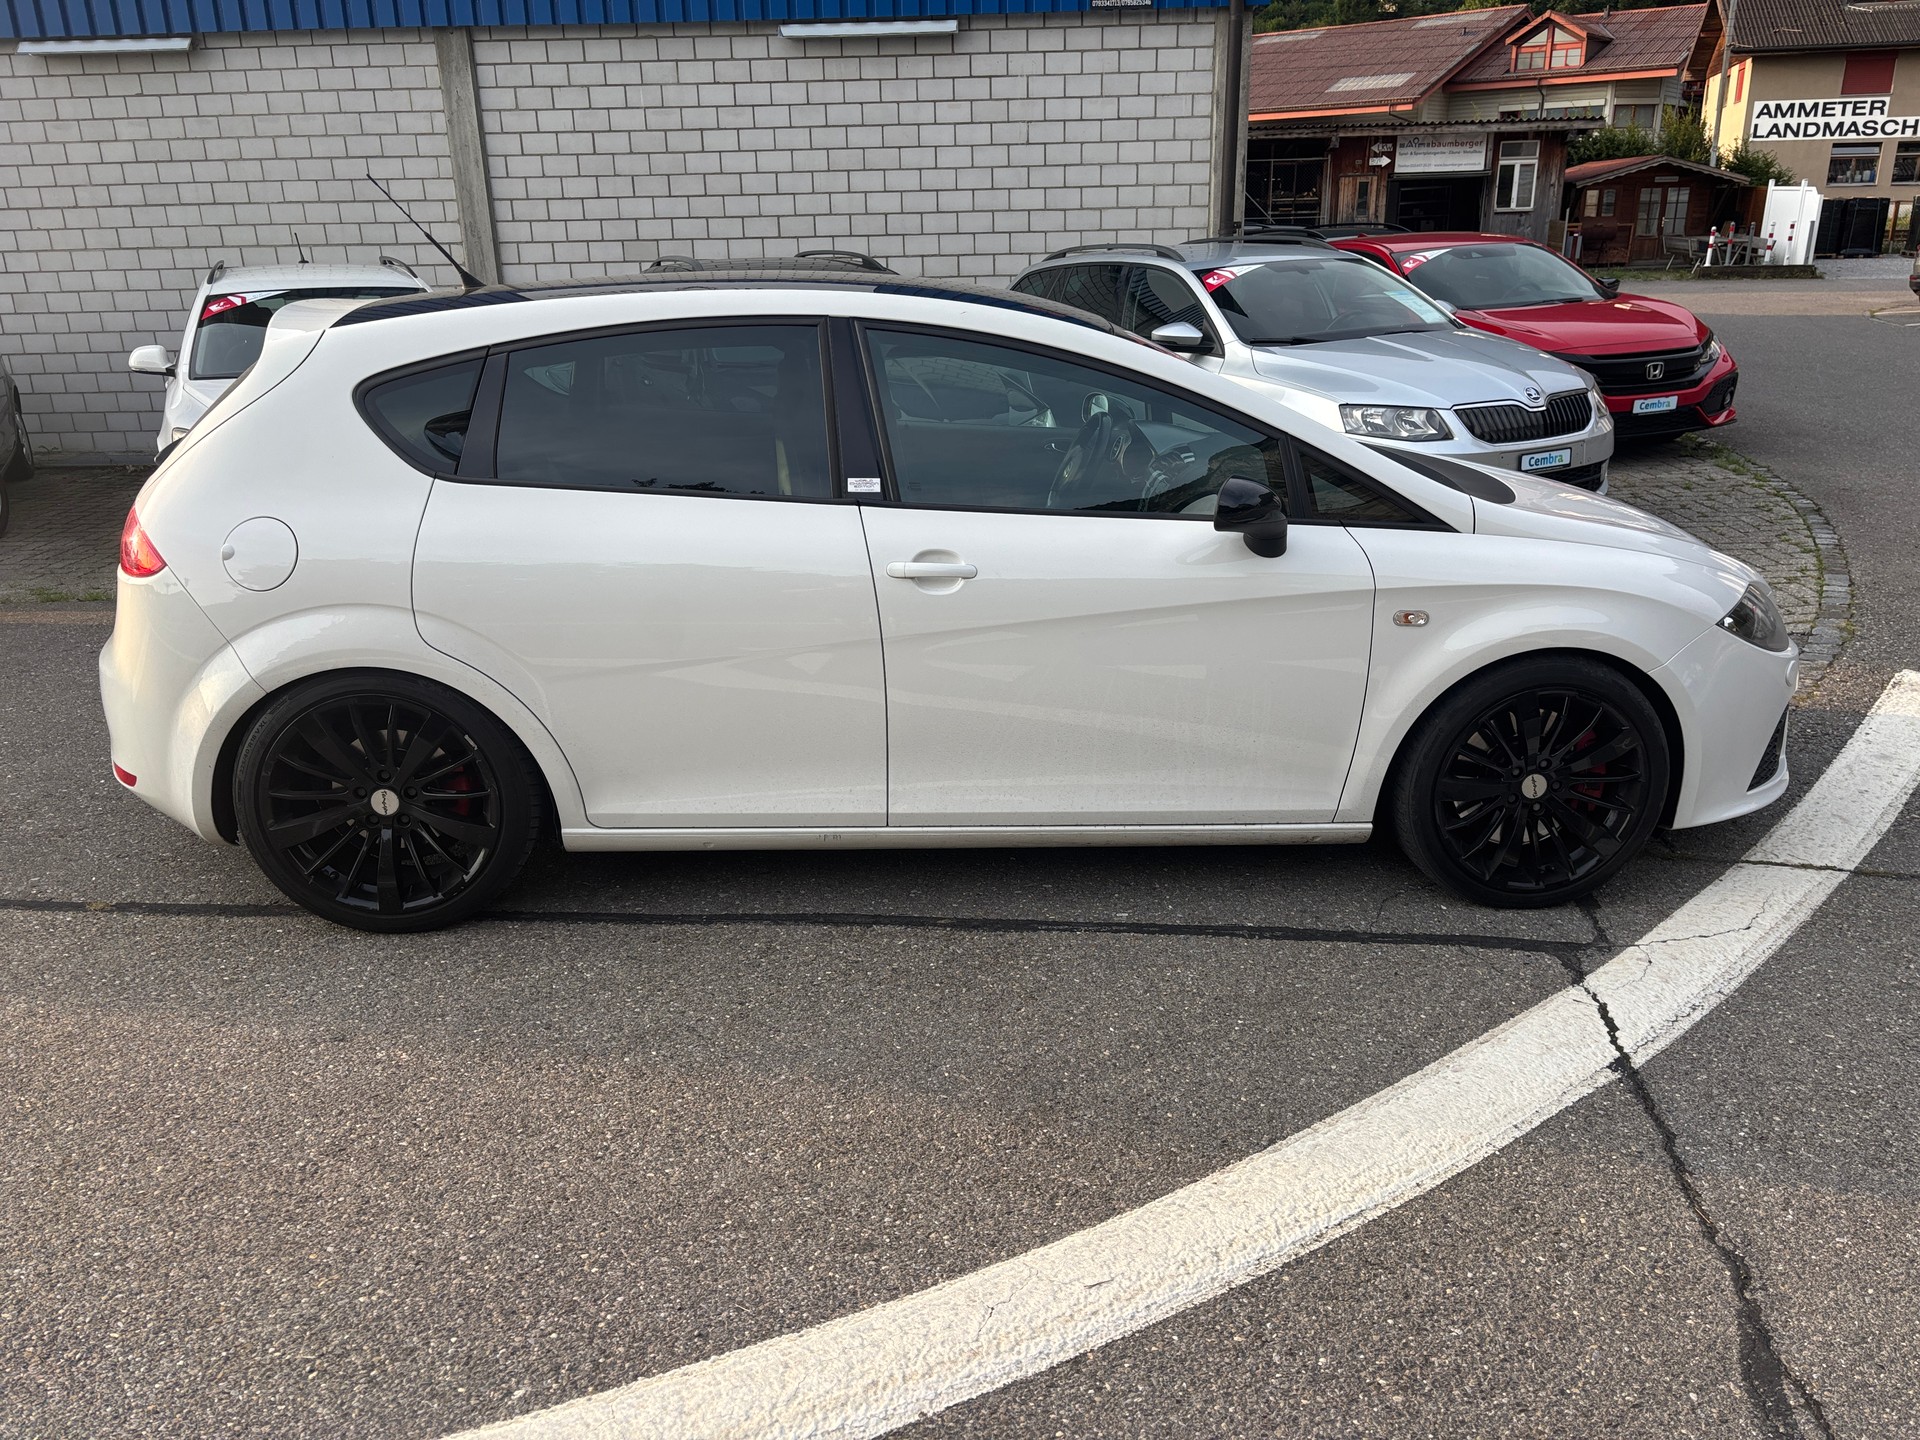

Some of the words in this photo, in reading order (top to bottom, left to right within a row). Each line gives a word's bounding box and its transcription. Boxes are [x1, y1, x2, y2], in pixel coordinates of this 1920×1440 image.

[1756, 99, 1887, 119] AMMETER
[1752, 118, 1920, 139] LANDMASCH
[1430, 139, 1484, 149] baumberger
[1639, 399, 1671, 410] Cembra
[1528, 453, 1564, 467] Cembra
